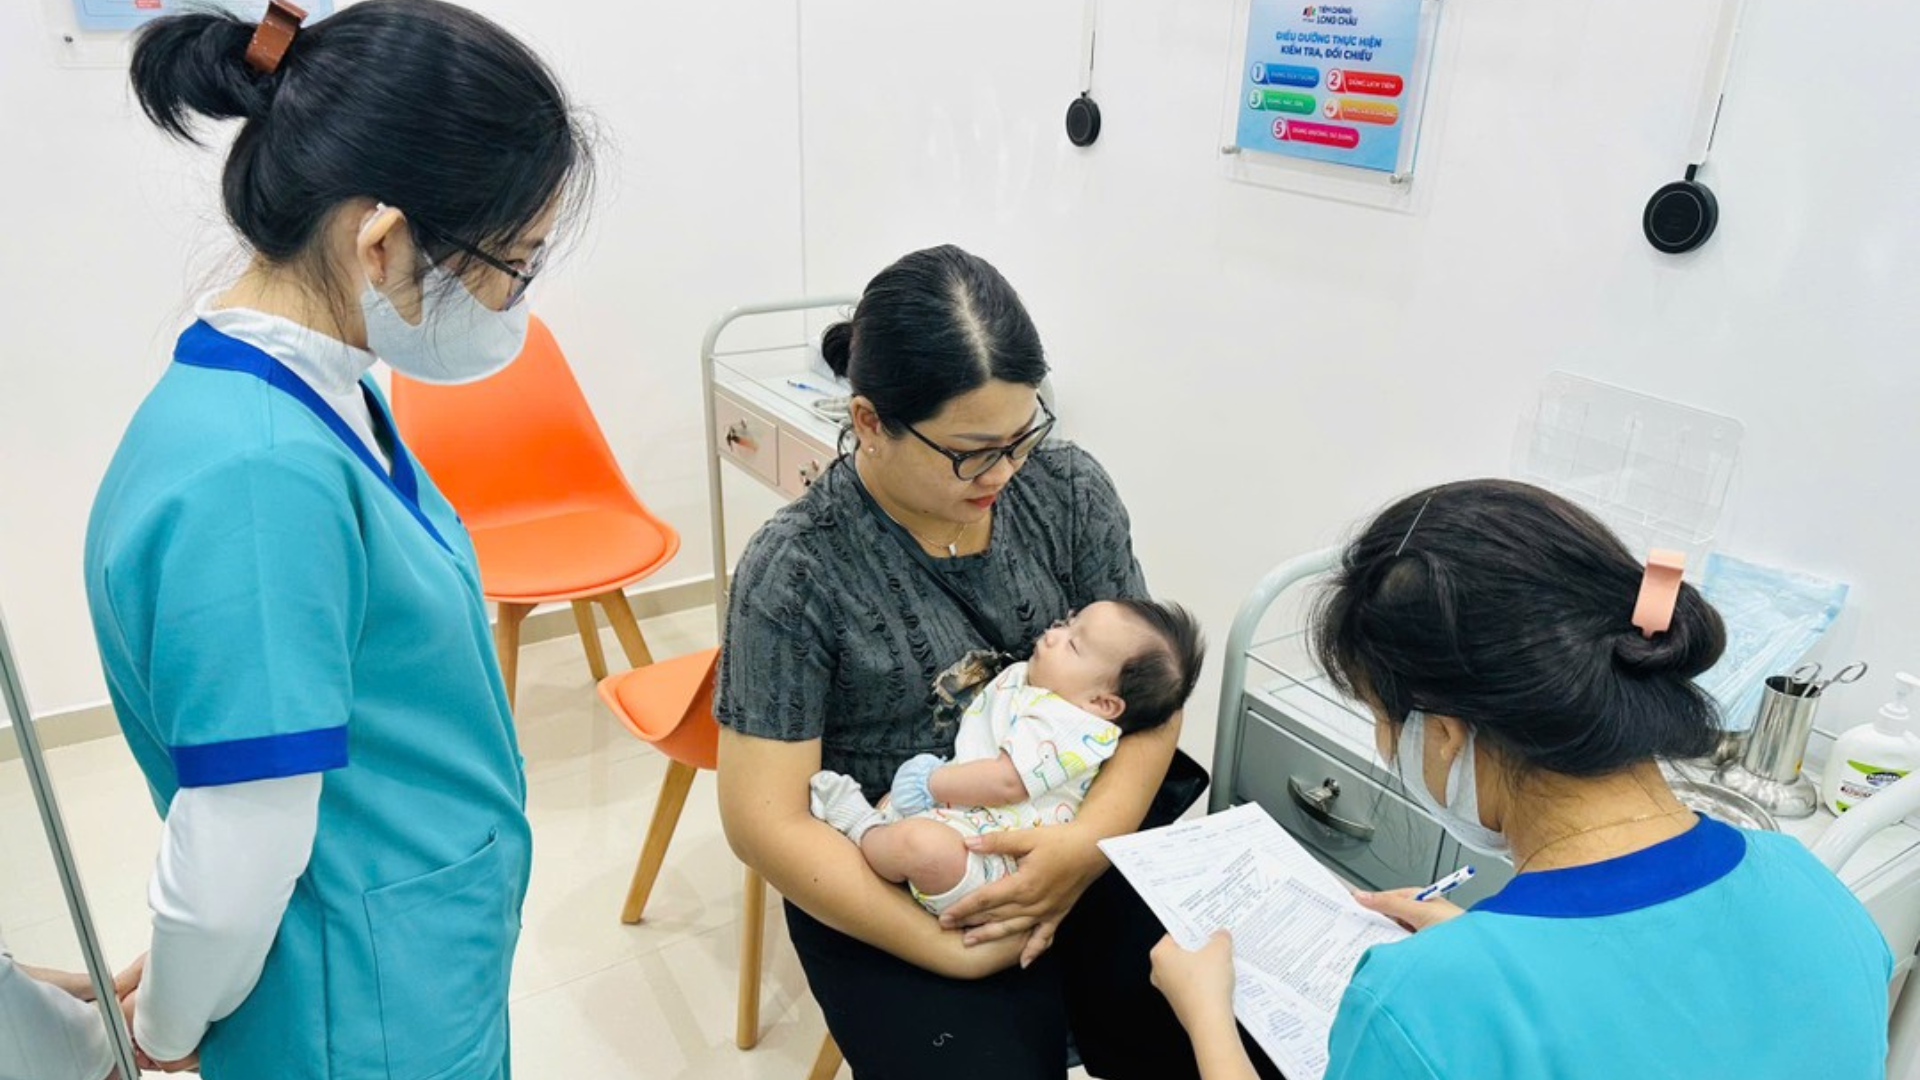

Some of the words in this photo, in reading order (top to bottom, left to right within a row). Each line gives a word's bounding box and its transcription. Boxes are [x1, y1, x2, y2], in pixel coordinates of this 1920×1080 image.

[1317, 16, 1336, 25] LONG
[1338, 16, 1358, 26] CHÂU
[1298, 31, 1330, 44] DƯỠNG
[1333, 34, 1357, 46] THỰC
[1359, 35, 1382, 48] HIỆN
[1304, 46, 1323, 58] TRA,
[1325, 47, 1342, 58] ĐỐI
[1344, 48, 1372, 61] CHIẾU
[1255, 66, 1261, 79] 1
[1330, 72, 1338, 85] 2
[1251, 92, 1258, 105] 3
[1274, 121, 1282, 135] 5
